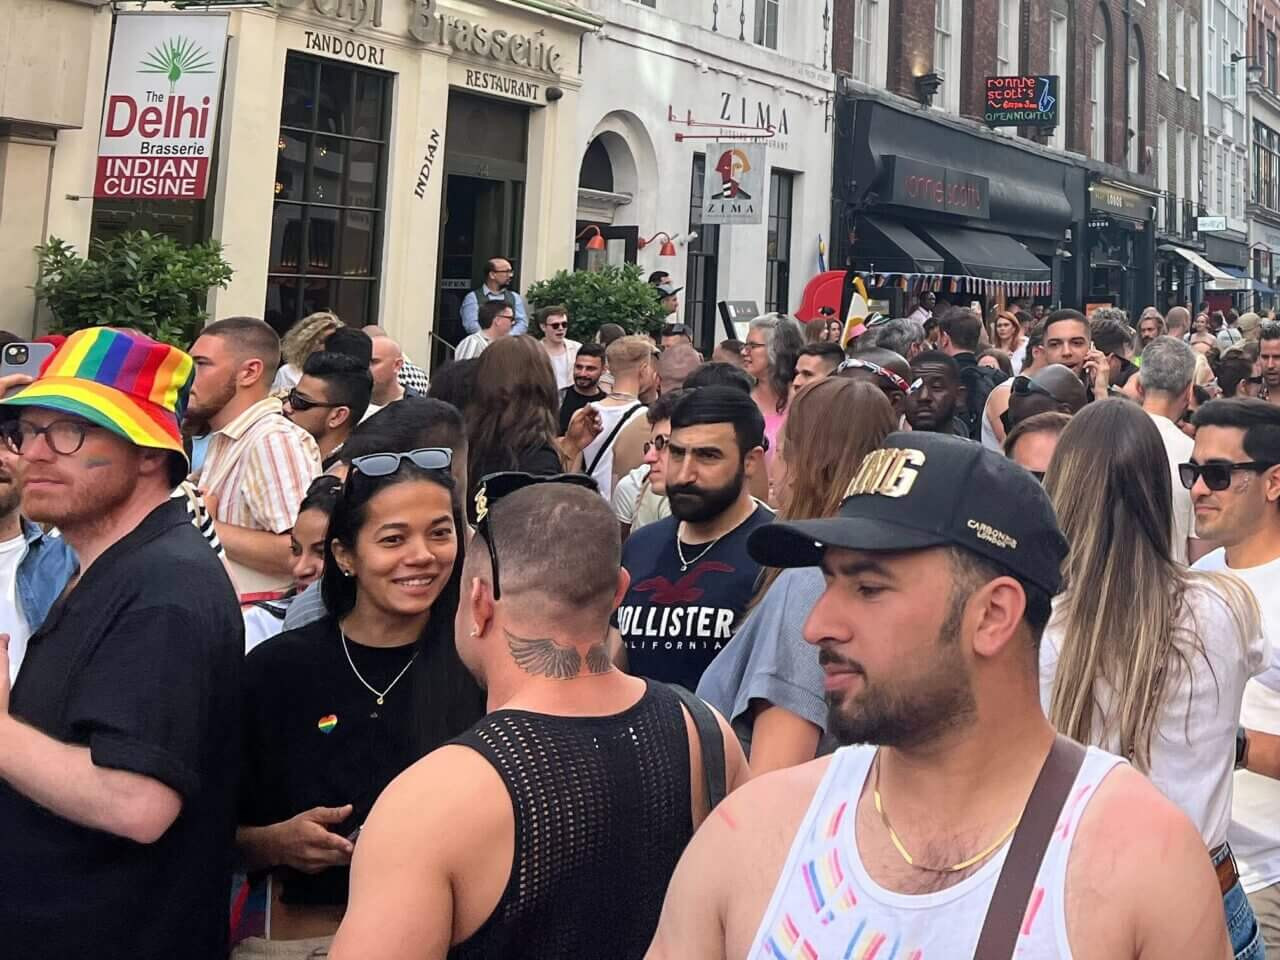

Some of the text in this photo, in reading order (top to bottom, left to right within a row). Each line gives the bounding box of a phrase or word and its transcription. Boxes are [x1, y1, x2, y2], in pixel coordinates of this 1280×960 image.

[304, 31, 385, 65] TANDOORI
[466, 69, 540, 100] RESTAURANT
[987, 77, 1035, 88] ronnie
[146, 91, 164, 102] The
[105, 95, 210, 139] Delhi
[720, 91, 789, 136] ZIMA
[140, 141, 205, 155] Brasserie
[106, 158, 198, 177] INDIAN
[414, 128, 441, 200] INDIAN
[103, 177, 196, 196] CUISINE
[707, 203, 754, 214] ZIMA
